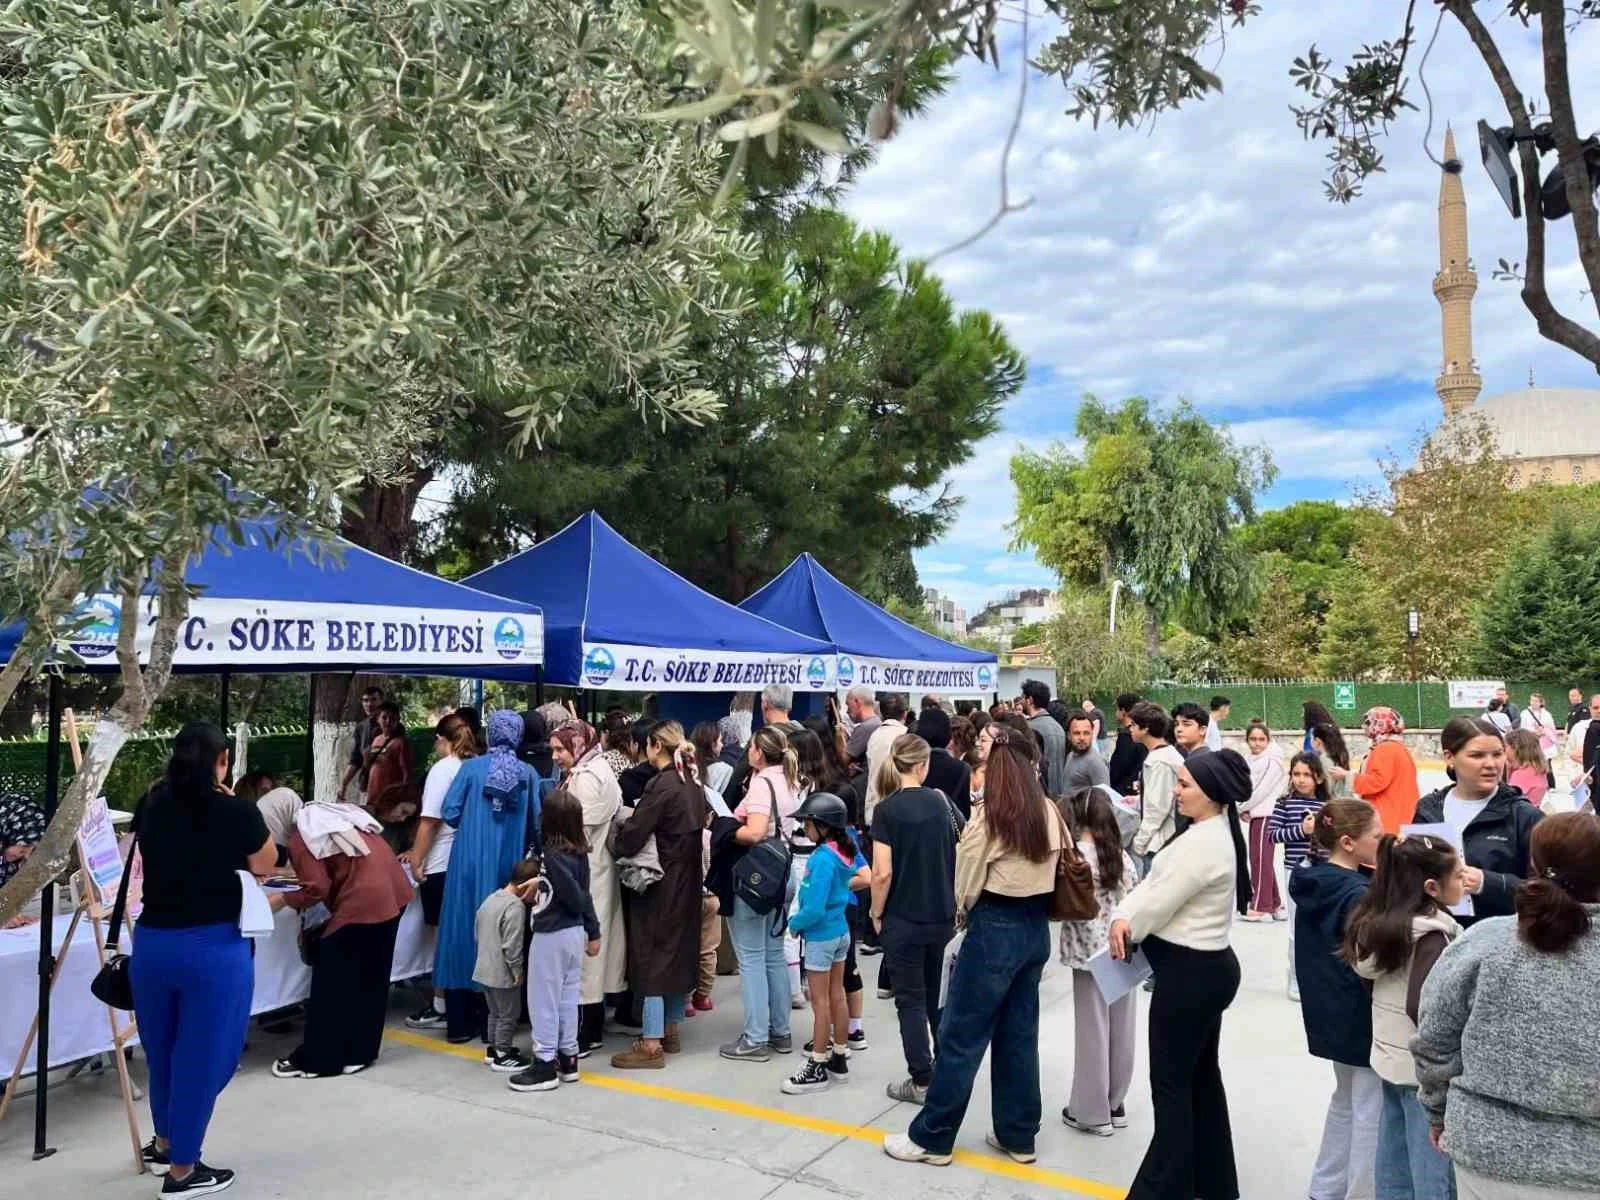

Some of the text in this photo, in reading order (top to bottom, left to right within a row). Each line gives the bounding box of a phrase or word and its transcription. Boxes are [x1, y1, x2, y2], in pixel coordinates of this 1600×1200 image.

[228, 608, 315, 652] SÖKE
[326, 616, 484, 653] BELEDİYESİ
[624, 655, 802, 684] T.C. SÖKE BELEDİYESİ
[860, 664, 975, 688] T.C. SÖKE BELEDİYESİ
